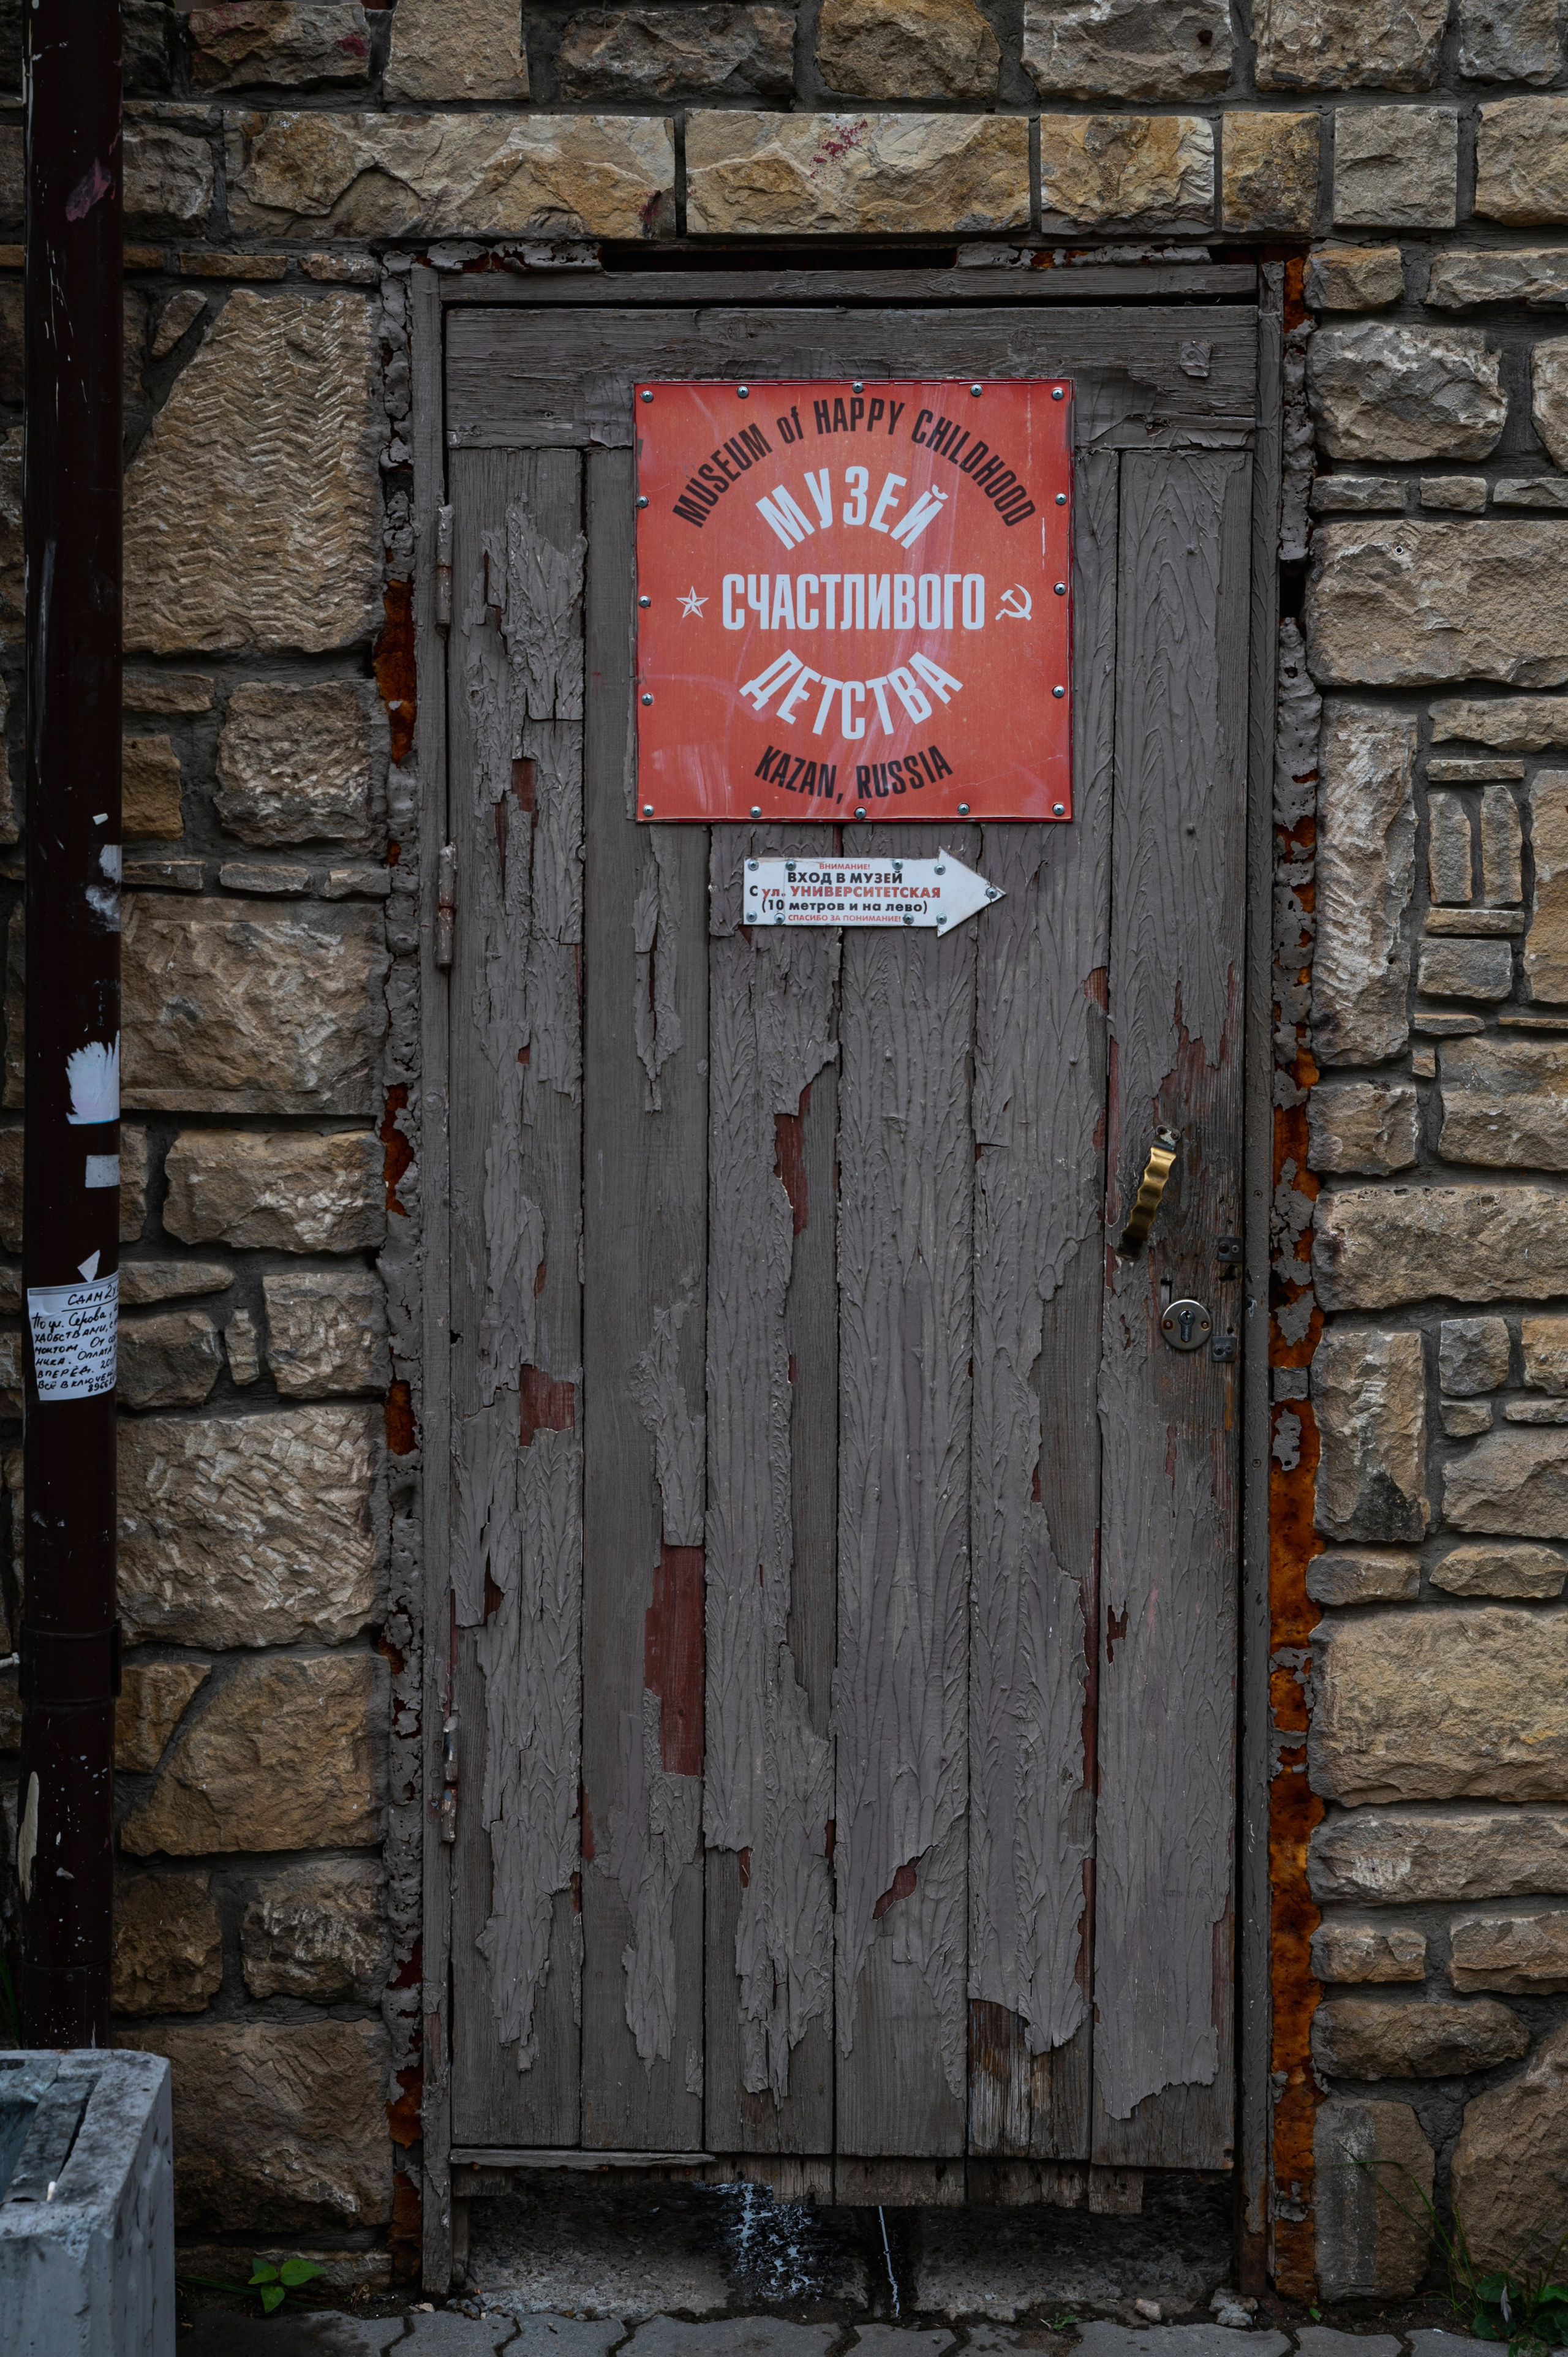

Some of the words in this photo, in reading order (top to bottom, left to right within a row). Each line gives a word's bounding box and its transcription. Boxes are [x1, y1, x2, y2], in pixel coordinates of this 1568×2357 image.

[673, 424, 772, 528] MUSEUM
[777, 405, 804, 444] of
[813, 397, 905, 435] HAPPY
[911, 409, 1036, 527] CHILDHOOD
[755, 466, 949, 550] МУЗЕЙ
[723, 574, 985, 630] СЧАСТЛИВОГО
[739, 649, 963, 740] ДЕТСТВА
[755, 745, 844, 804] KAZAN,
[858, 745, 953, 799] RUSSIA
[761, 888, 786, 900] ул.
[790, 886, 941, 898] УНИВЕРСИТЕТСКАЯ
[788, 872, 832, 884] ВХОД
[836, 873, 846, 883] В
[850, 870, 903, 884] МУЗЕЙ
[761, 899, 785, 913] (10
[789, 902, 845, 913] метров
[862, 903, 881, 911] на
[885, 900, 927, 915] лево)
